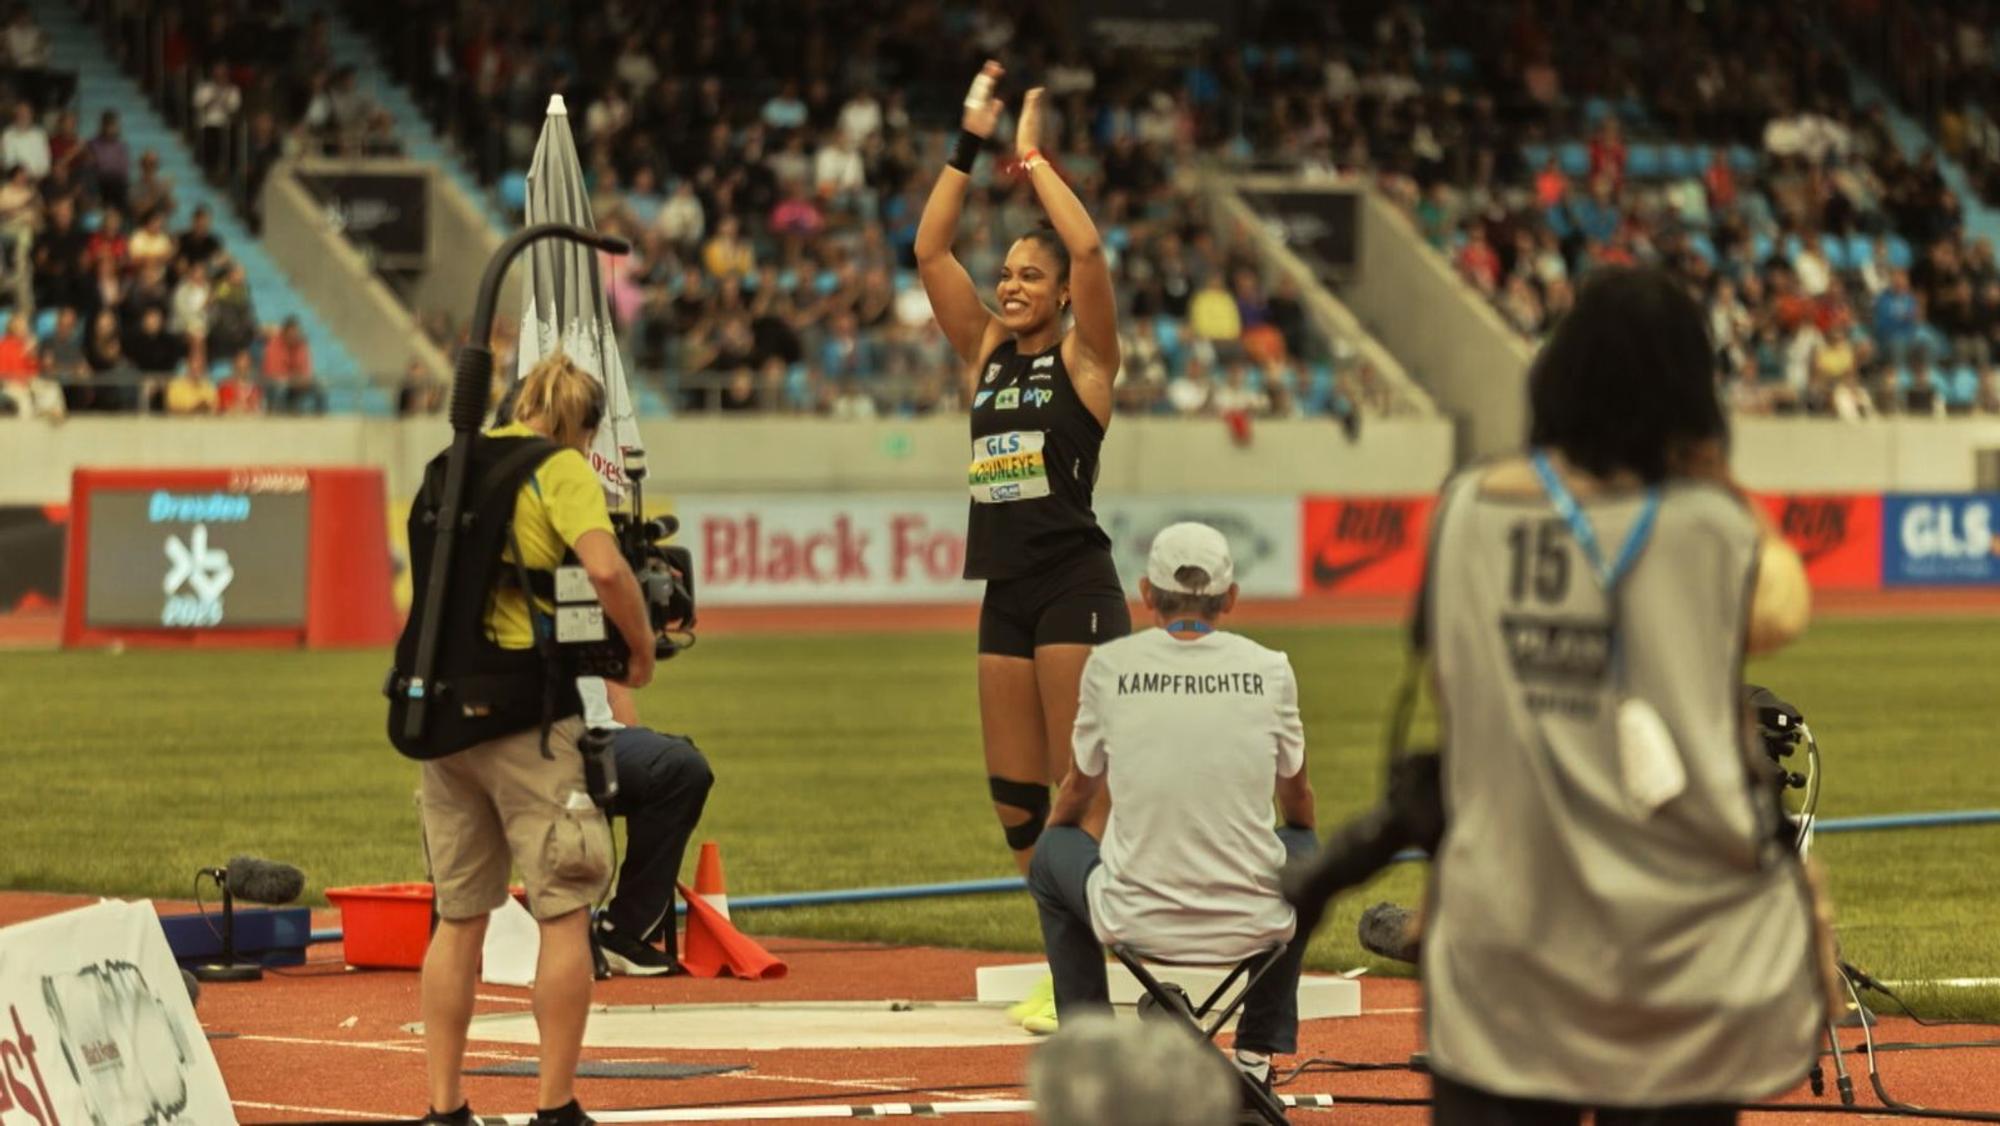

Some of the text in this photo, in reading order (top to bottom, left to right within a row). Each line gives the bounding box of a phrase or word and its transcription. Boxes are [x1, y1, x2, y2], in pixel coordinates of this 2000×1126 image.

[986, 435, 1020, 456] GLS
[149, 491, 249, 522] Dresden
[1902, 501, 1992, 559] GLS
[702, 513, 871, 585] Black
[1508, 517, 1573, 606] 15
[162, 597, 224, 627] 2025
[1117, 672, 1264, 695] KAMPFRICHTER
